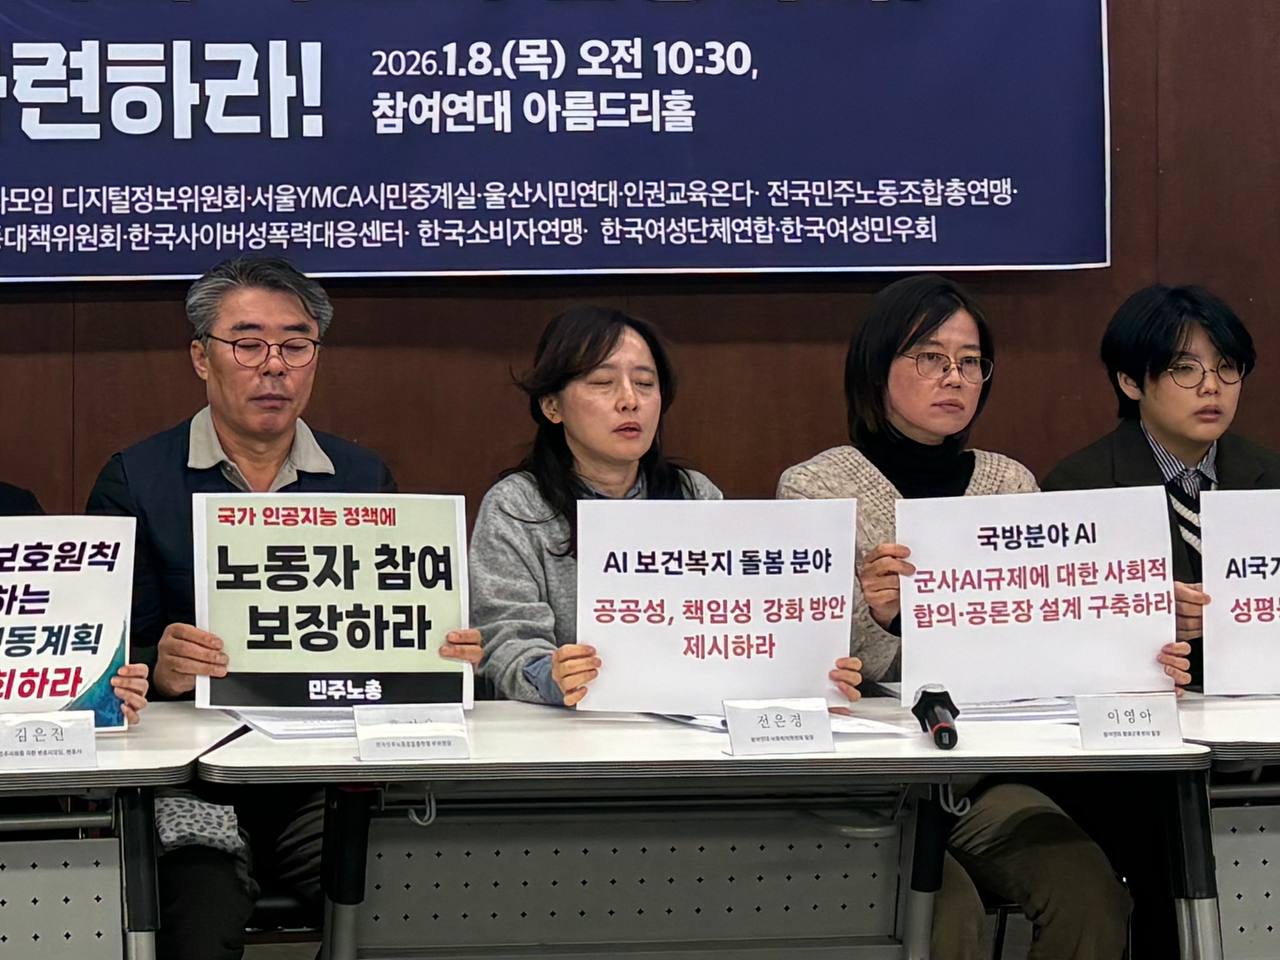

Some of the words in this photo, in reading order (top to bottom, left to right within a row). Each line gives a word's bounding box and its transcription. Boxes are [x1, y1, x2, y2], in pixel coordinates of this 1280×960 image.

[372, 39, 565, 80] 2026.1.8.(목)
[578, 38, 642, 78] 오전
[653, 41, 757, 79] 10:30,
[372, 90, 511, 133] 참여연대
[523, 90, 695, 132] 아름드리홀
[218, 508, 256, 526] 국가
[263, 507, 337, 526] 인공지능
[344, 507, 396, 526] 정책에
[978, 523, 1069, 551] 국방분야
[1075, 523, 1096, 544] AI
[216, 545, 360, 592] 노동자
[375, 544, 452, 590] 참여
[604, 552, 627, 573] AI
[635, 550, 731, 575] 보건복지
[740, 550, 784, 575] 돌봄
[790, 548, 831, 573] 분야
[912, 564, 1049, 593] 군사AI규제에
[1057, 562, 1098, 587] 대한
[1105, 557, 1166, 584] 사회적
[594, 599, 674, 626] 공공성,
[683, 599, 751, 624] 책임성
[764, 598, 804, 623] 강화
[810, 595, 846, 621] 방안
[913, 599, 1033, 628] 합의·공론장
[1040, 596, 1081, 621] 설계
[1088, 591, 1172, 619] 구축하라
[1231, 597, 1280, 623] 성평
[247, 604, 431, 652] 보장하라
[683, 633, 775, 659] 제시하라
[309, 679, 381, 700] 민주노총
